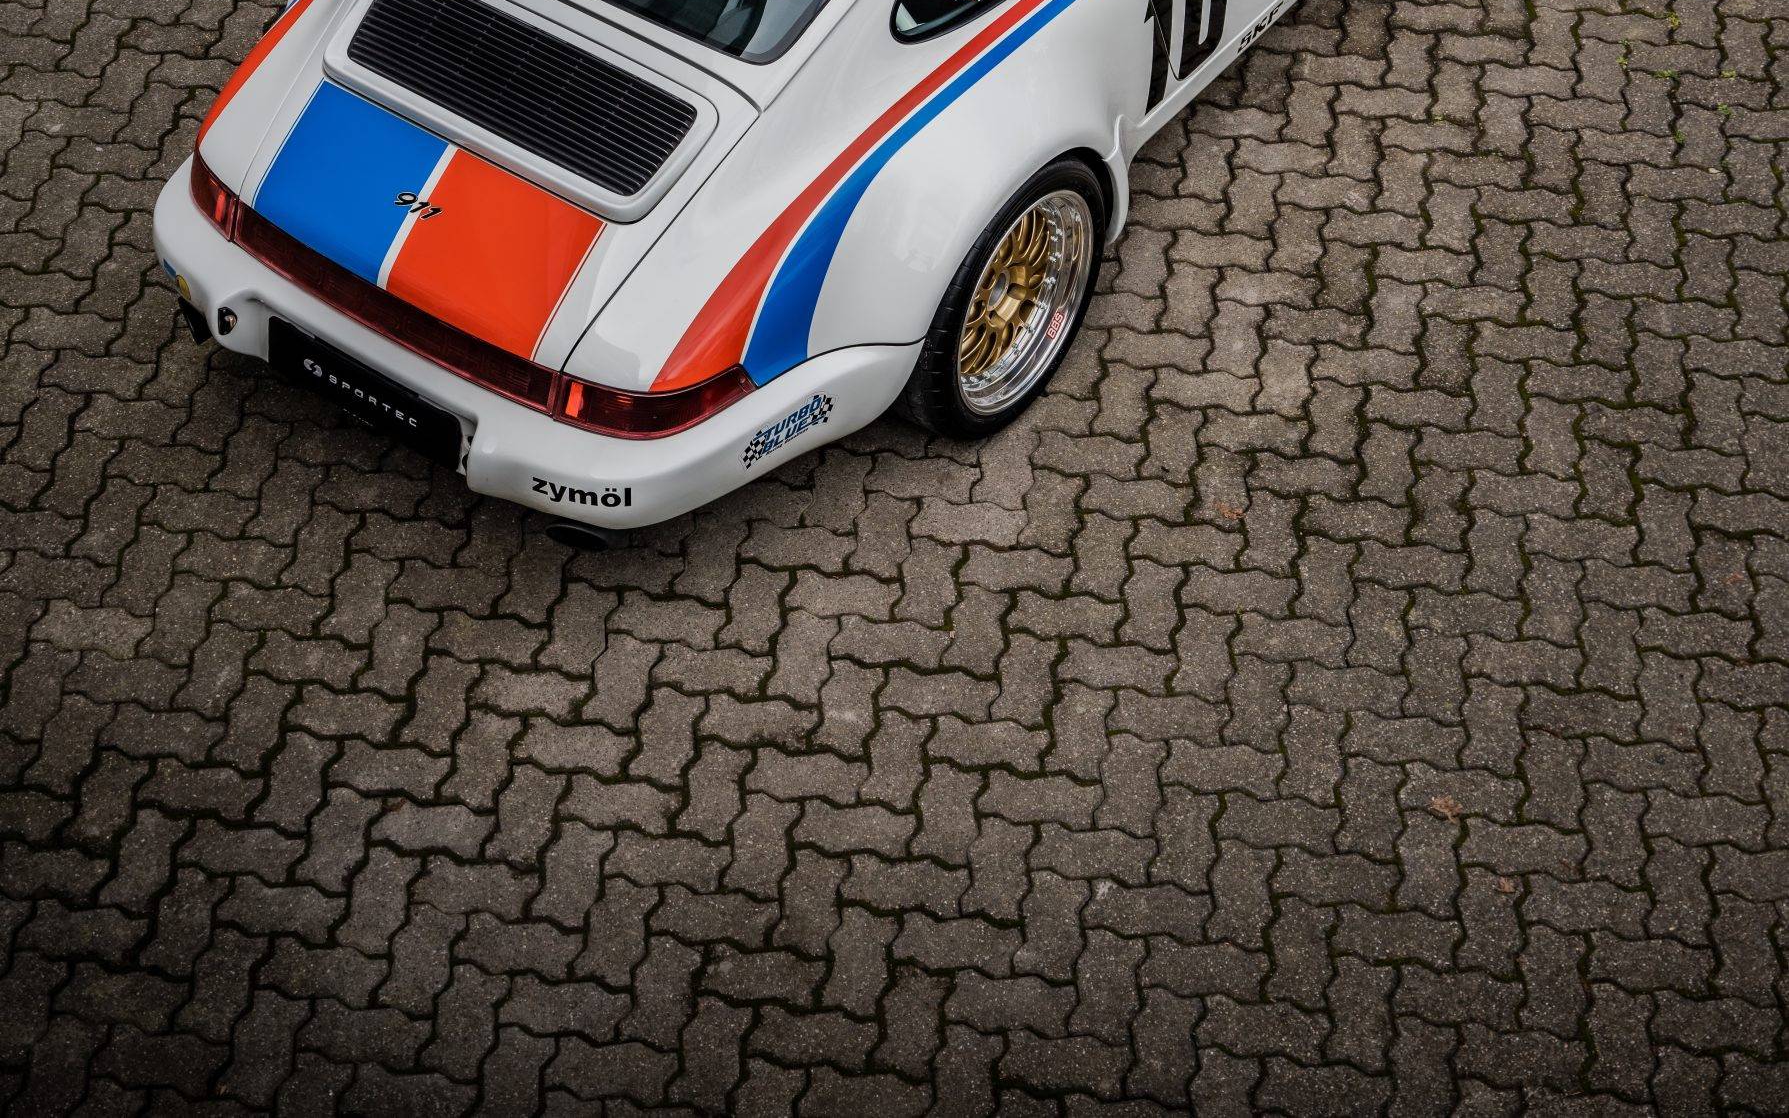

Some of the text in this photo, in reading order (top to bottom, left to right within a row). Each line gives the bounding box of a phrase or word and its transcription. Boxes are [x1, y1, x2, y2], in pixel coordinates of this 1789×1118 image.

[1237, 1, 1284, 54] SKF
[395, 192, 443, 220] 911
[1047, 312, 1064, 339] BBS
[329, 374, 417, 428] SPORTEC
[755, 396, 822, 441] TURBO
[761, 415, 824, 456] BLUE
[532, 476, 632, 507] zymöl
